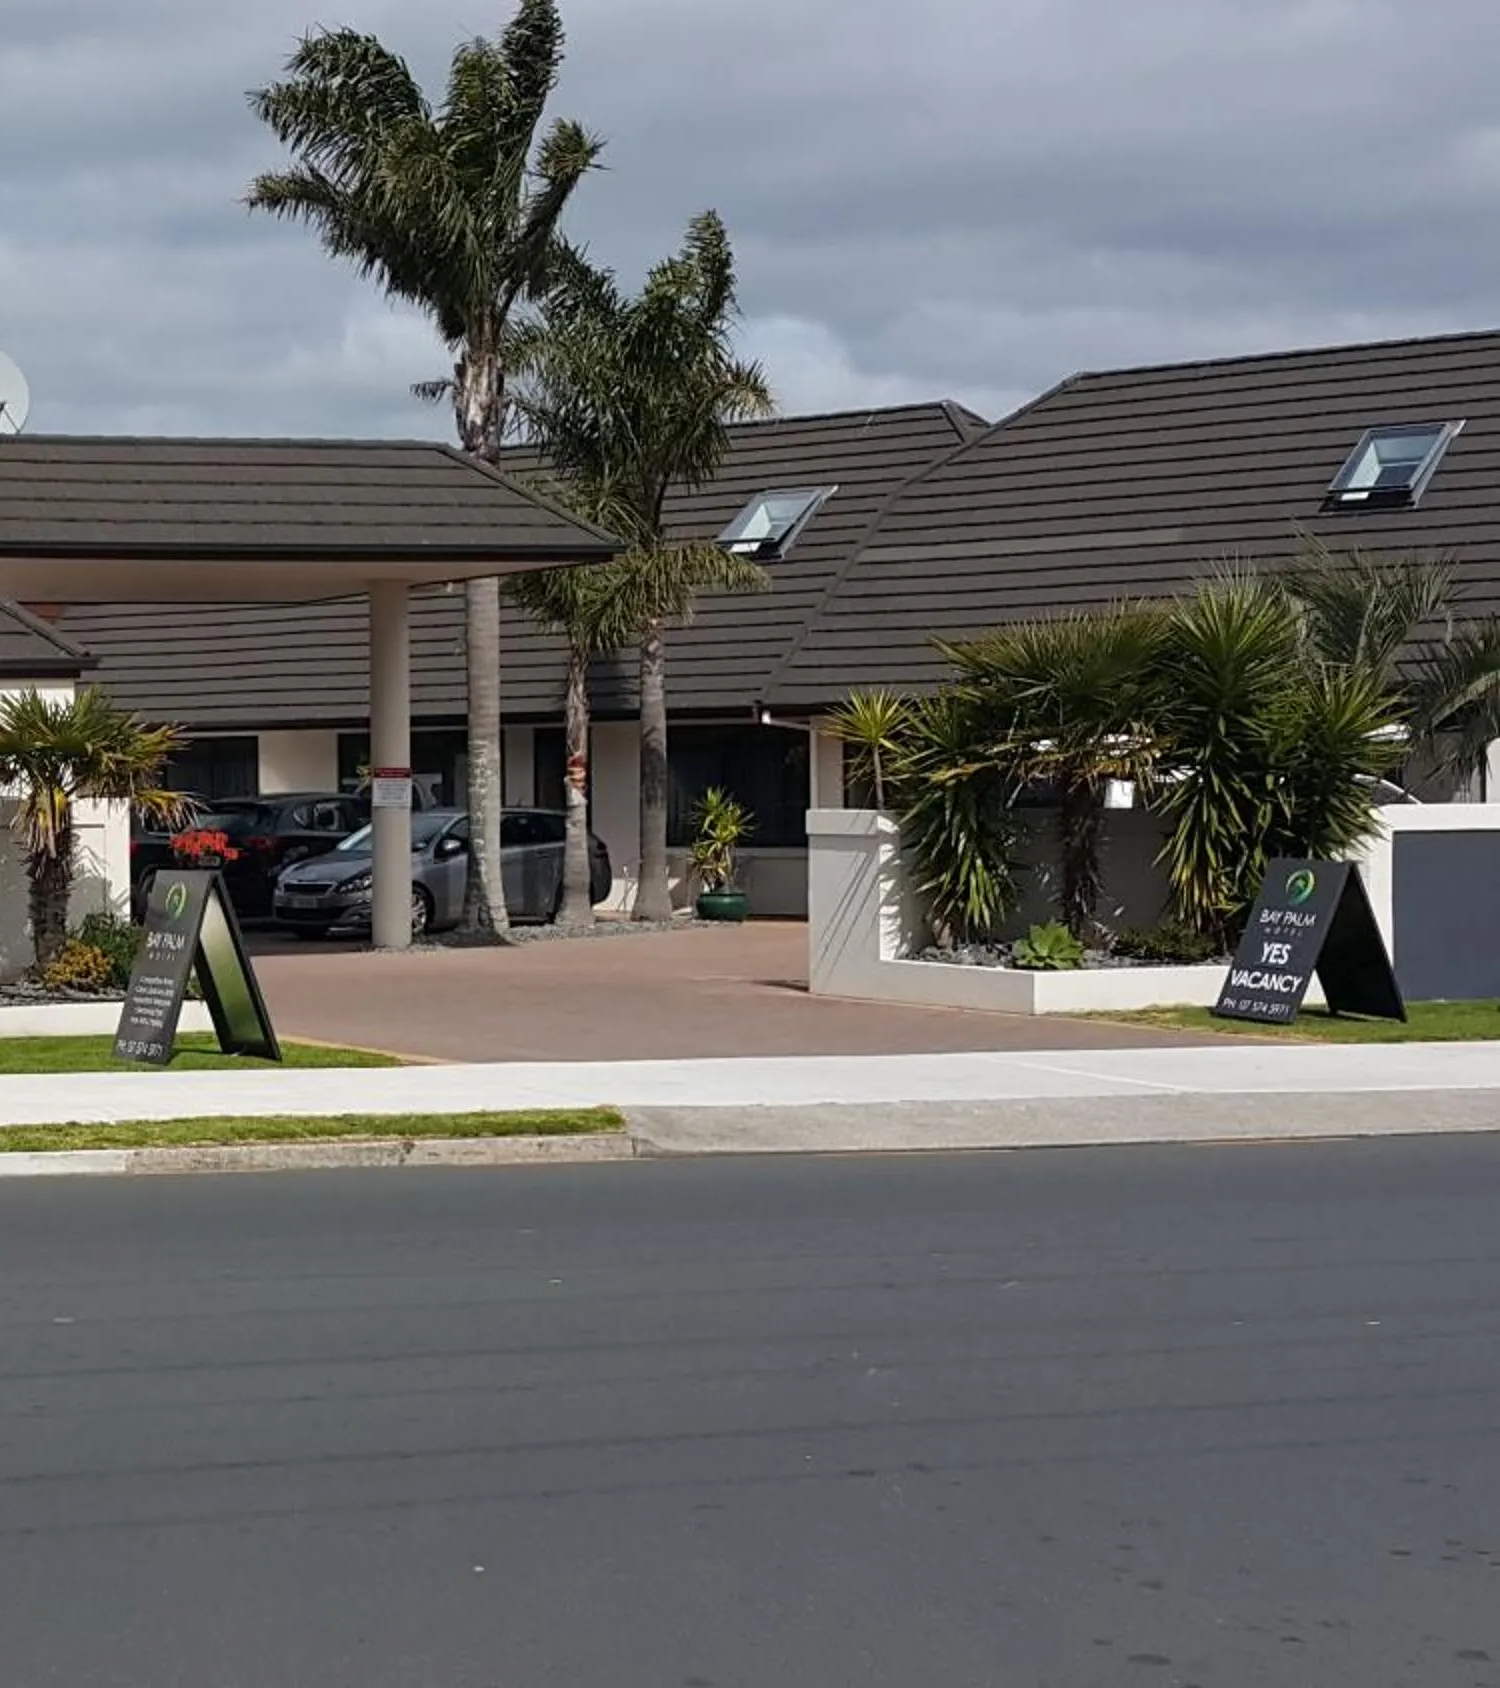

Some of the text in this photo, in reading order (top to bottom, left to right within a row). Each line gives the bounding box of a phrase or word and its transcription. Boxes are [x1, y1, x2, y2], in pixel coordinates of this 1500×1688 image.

[1259, 908, 1316, 927] BAY PALM
[1260, 942, 1291, 965] YES
[1230, 969, 1303, 993] VACANCY
